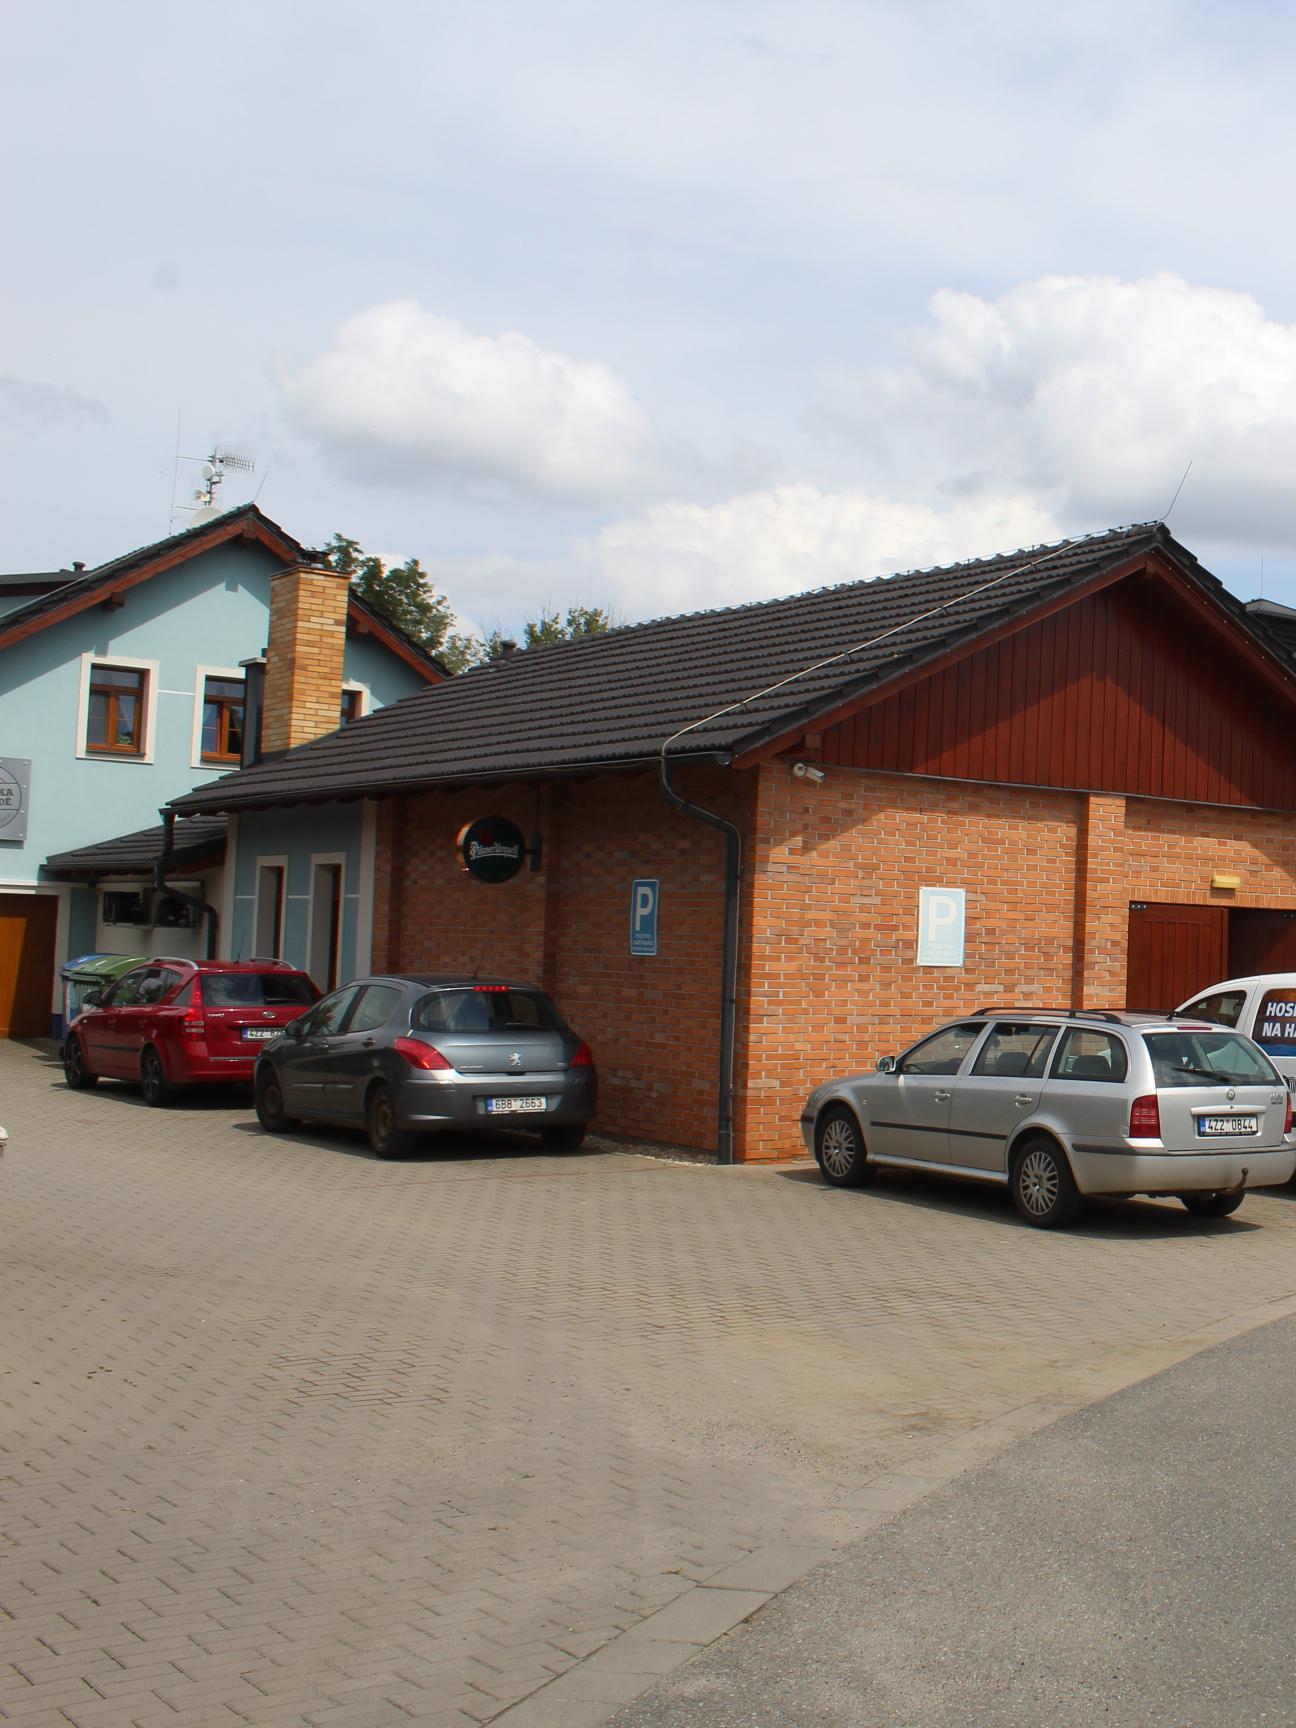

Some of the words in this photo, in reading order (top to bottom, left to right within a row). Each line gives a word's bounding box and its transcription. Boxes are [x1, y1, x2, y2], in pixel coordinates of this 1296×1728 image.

[635, 886, 654, 931] P
[928, 895, 956, 941] P
[1262, 1022, 1281, 1037] NA
[519, 1097, 543, 1109] 2663
[1207, 1119, 1225, 1131] 4Z2
[1231, 1118, 1253, 1131] 0844
